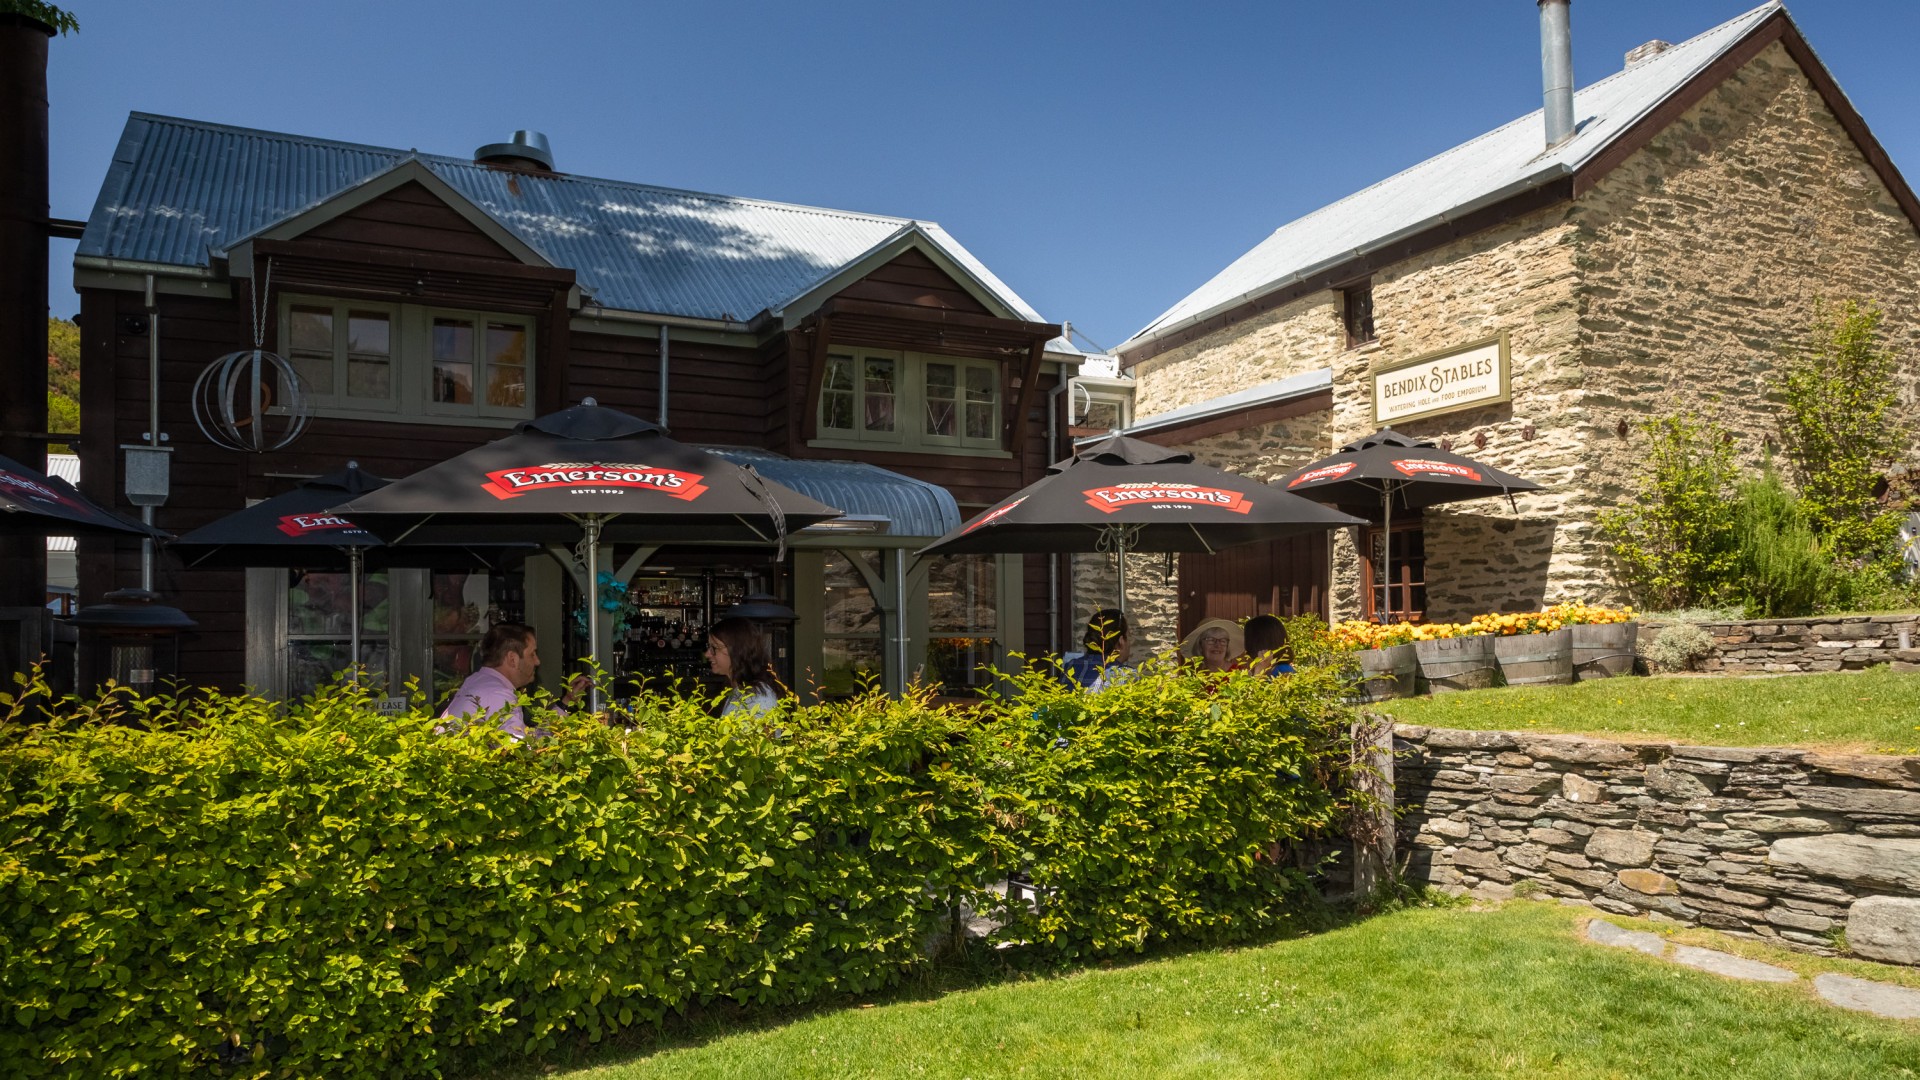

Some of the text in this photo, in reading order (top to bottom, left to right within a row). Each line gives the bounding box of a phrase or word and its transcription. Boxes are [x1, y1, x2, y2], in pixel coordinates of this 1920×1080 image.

[1384, 358, 1492, 398] BENDIX STABLES
[1389, 402, 1416, 413] WATERING
[1418, 397, 1432, 406] HOLE
[1441, 392, 1455, 401] FOOD
[1457, 385, 1487, 398] EMPORIUM
[503, 469, 686, 488] Emerson's
[1095, 489, 1232, 504] Emerson's
